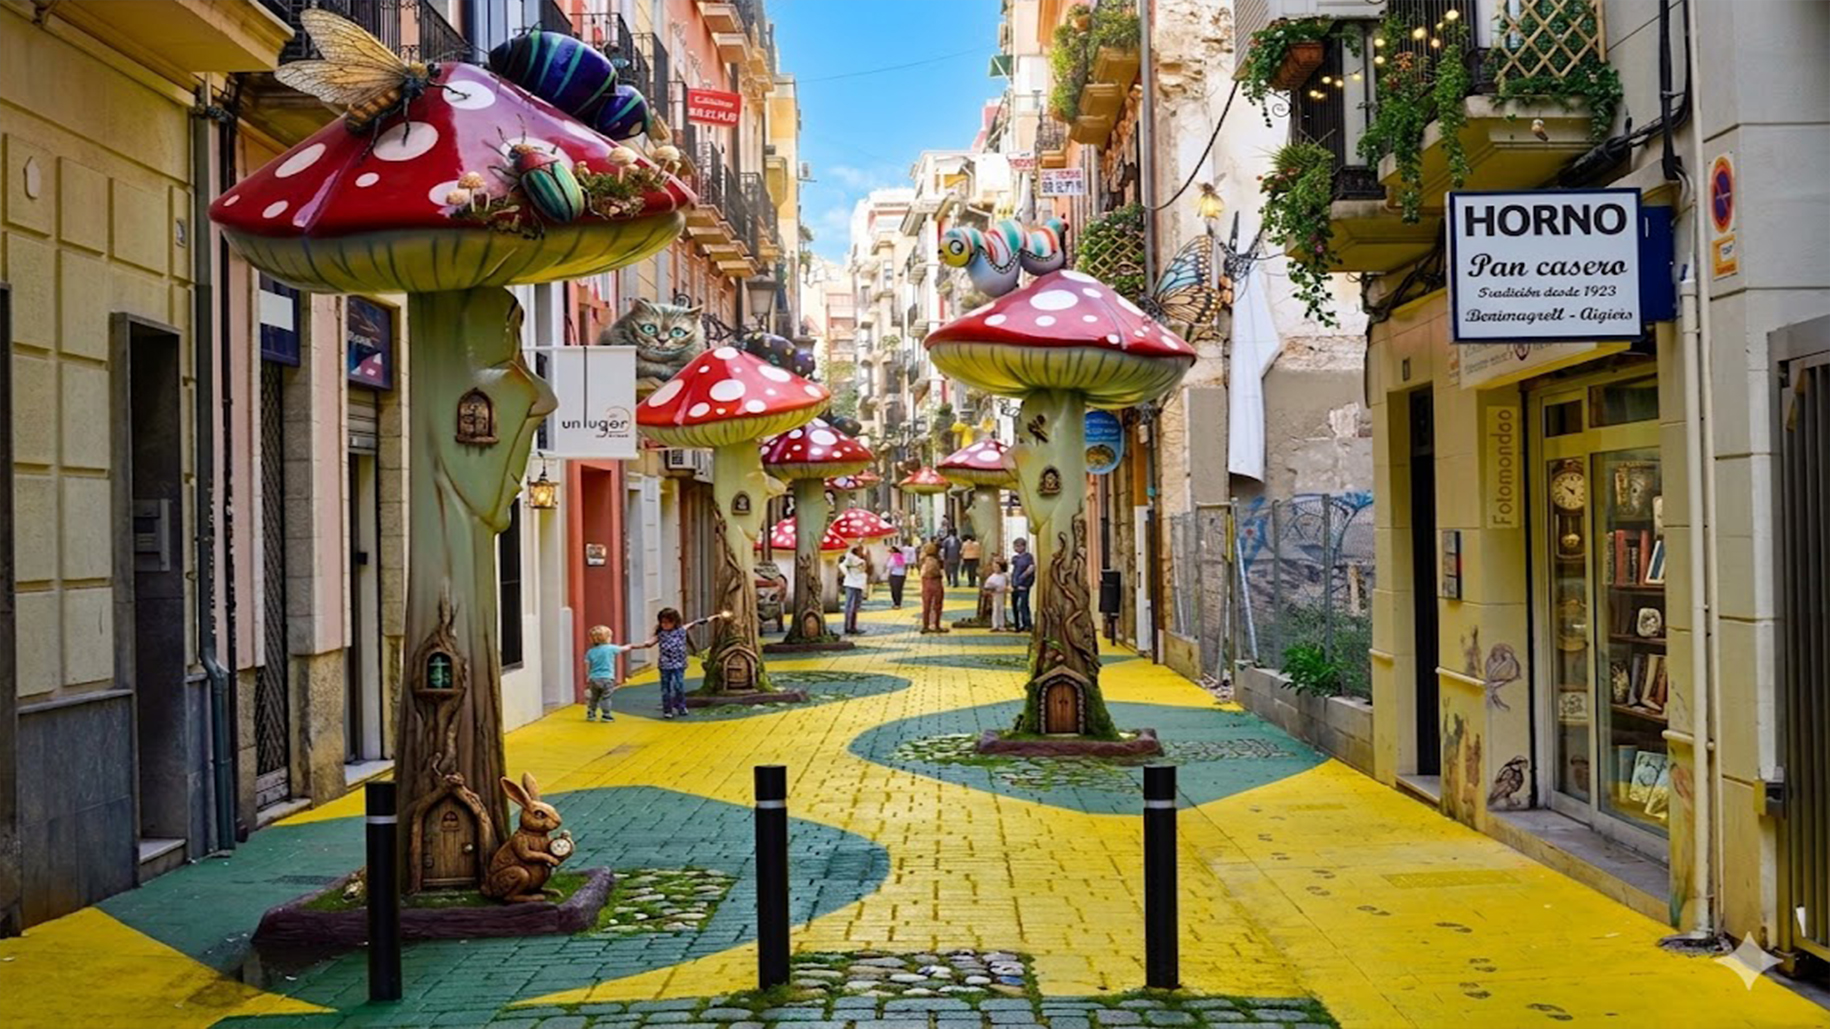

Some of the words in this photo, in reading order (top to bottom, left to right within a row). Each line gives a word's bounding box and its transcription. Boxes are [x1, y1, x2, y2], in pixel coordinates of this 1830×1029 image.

[1465, 203, 1627, 237] HORNO
[1467, 252, 1529, 277] Pan
[1536, 260, 1628, 276] casero
[1543, 286, 1581, 298] desde
[1584, 285, 1617, 297] 1923
